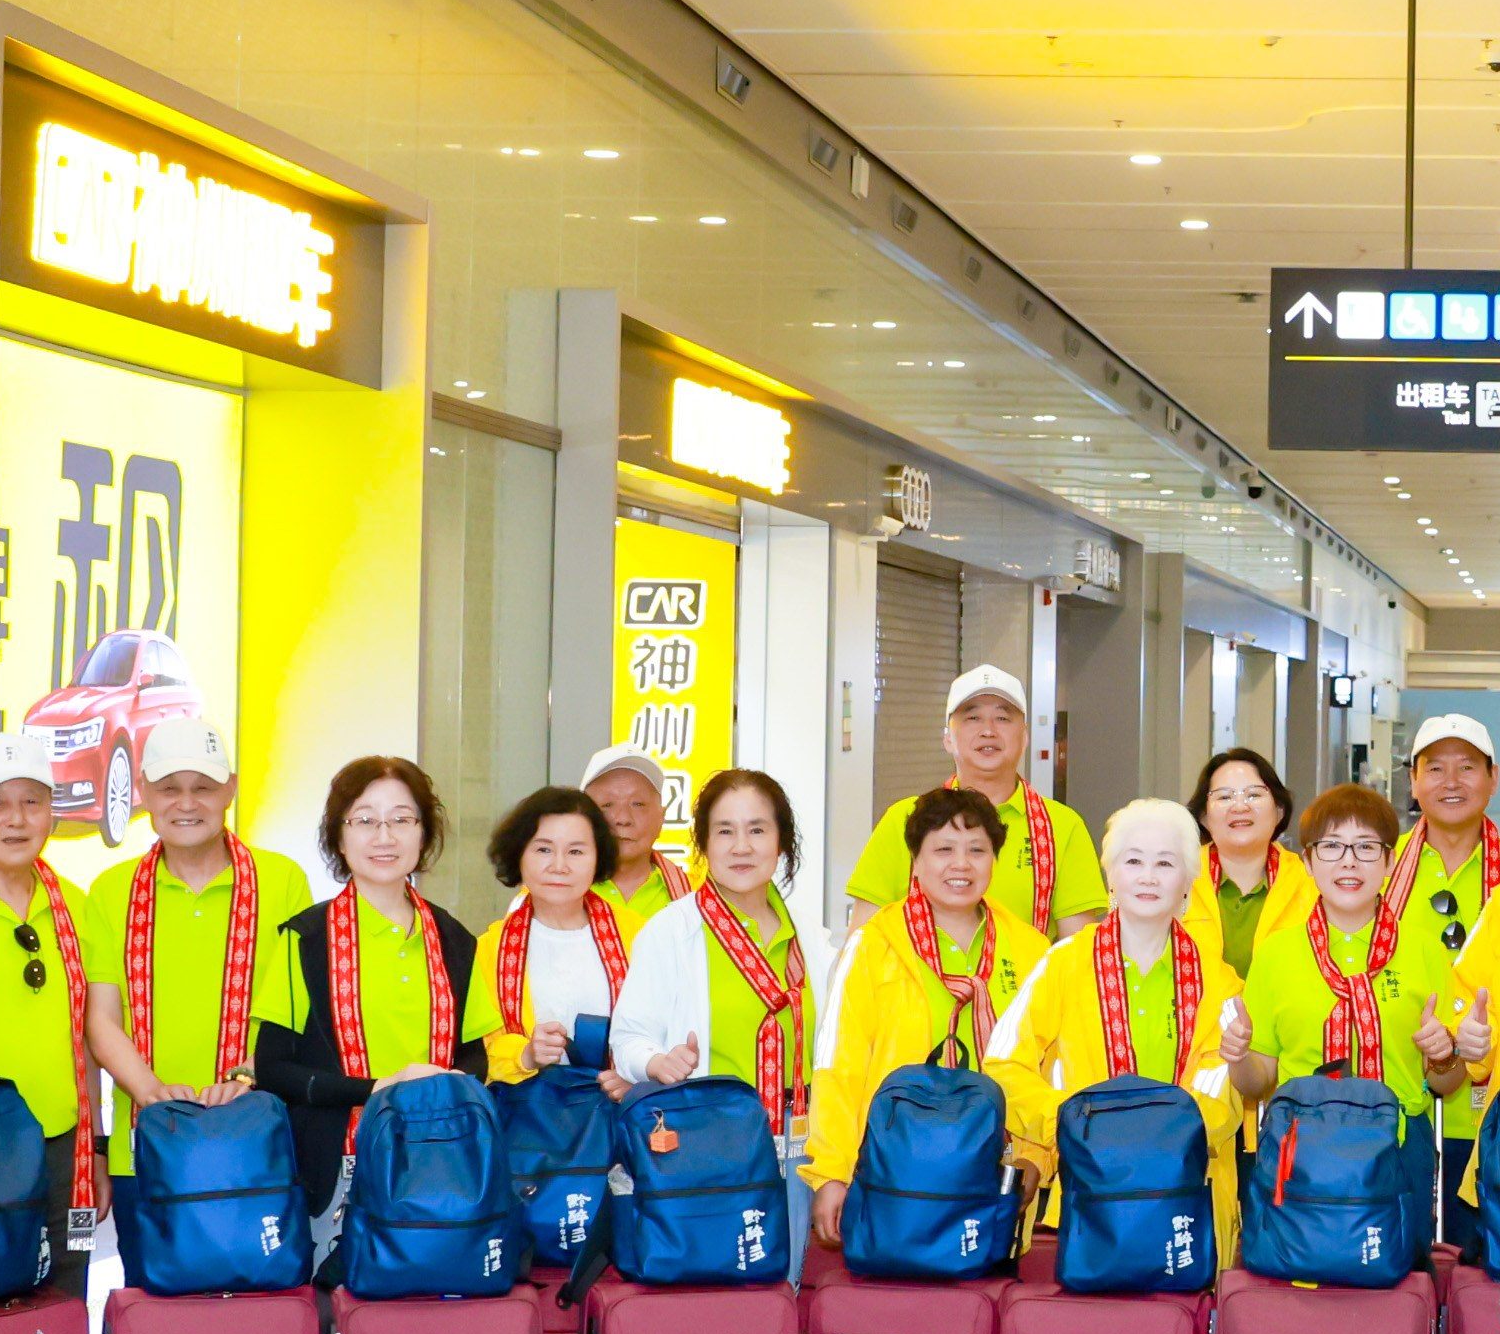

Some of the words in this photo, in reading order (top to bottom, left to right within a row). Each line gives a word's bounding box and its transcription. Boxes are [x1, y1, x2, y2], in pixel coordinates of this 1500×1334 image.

[1396, 381, 1470, 409] 出租车
[1442, 410, 1470, 425] Taxi
[628, 585, 698, 623] CAR
